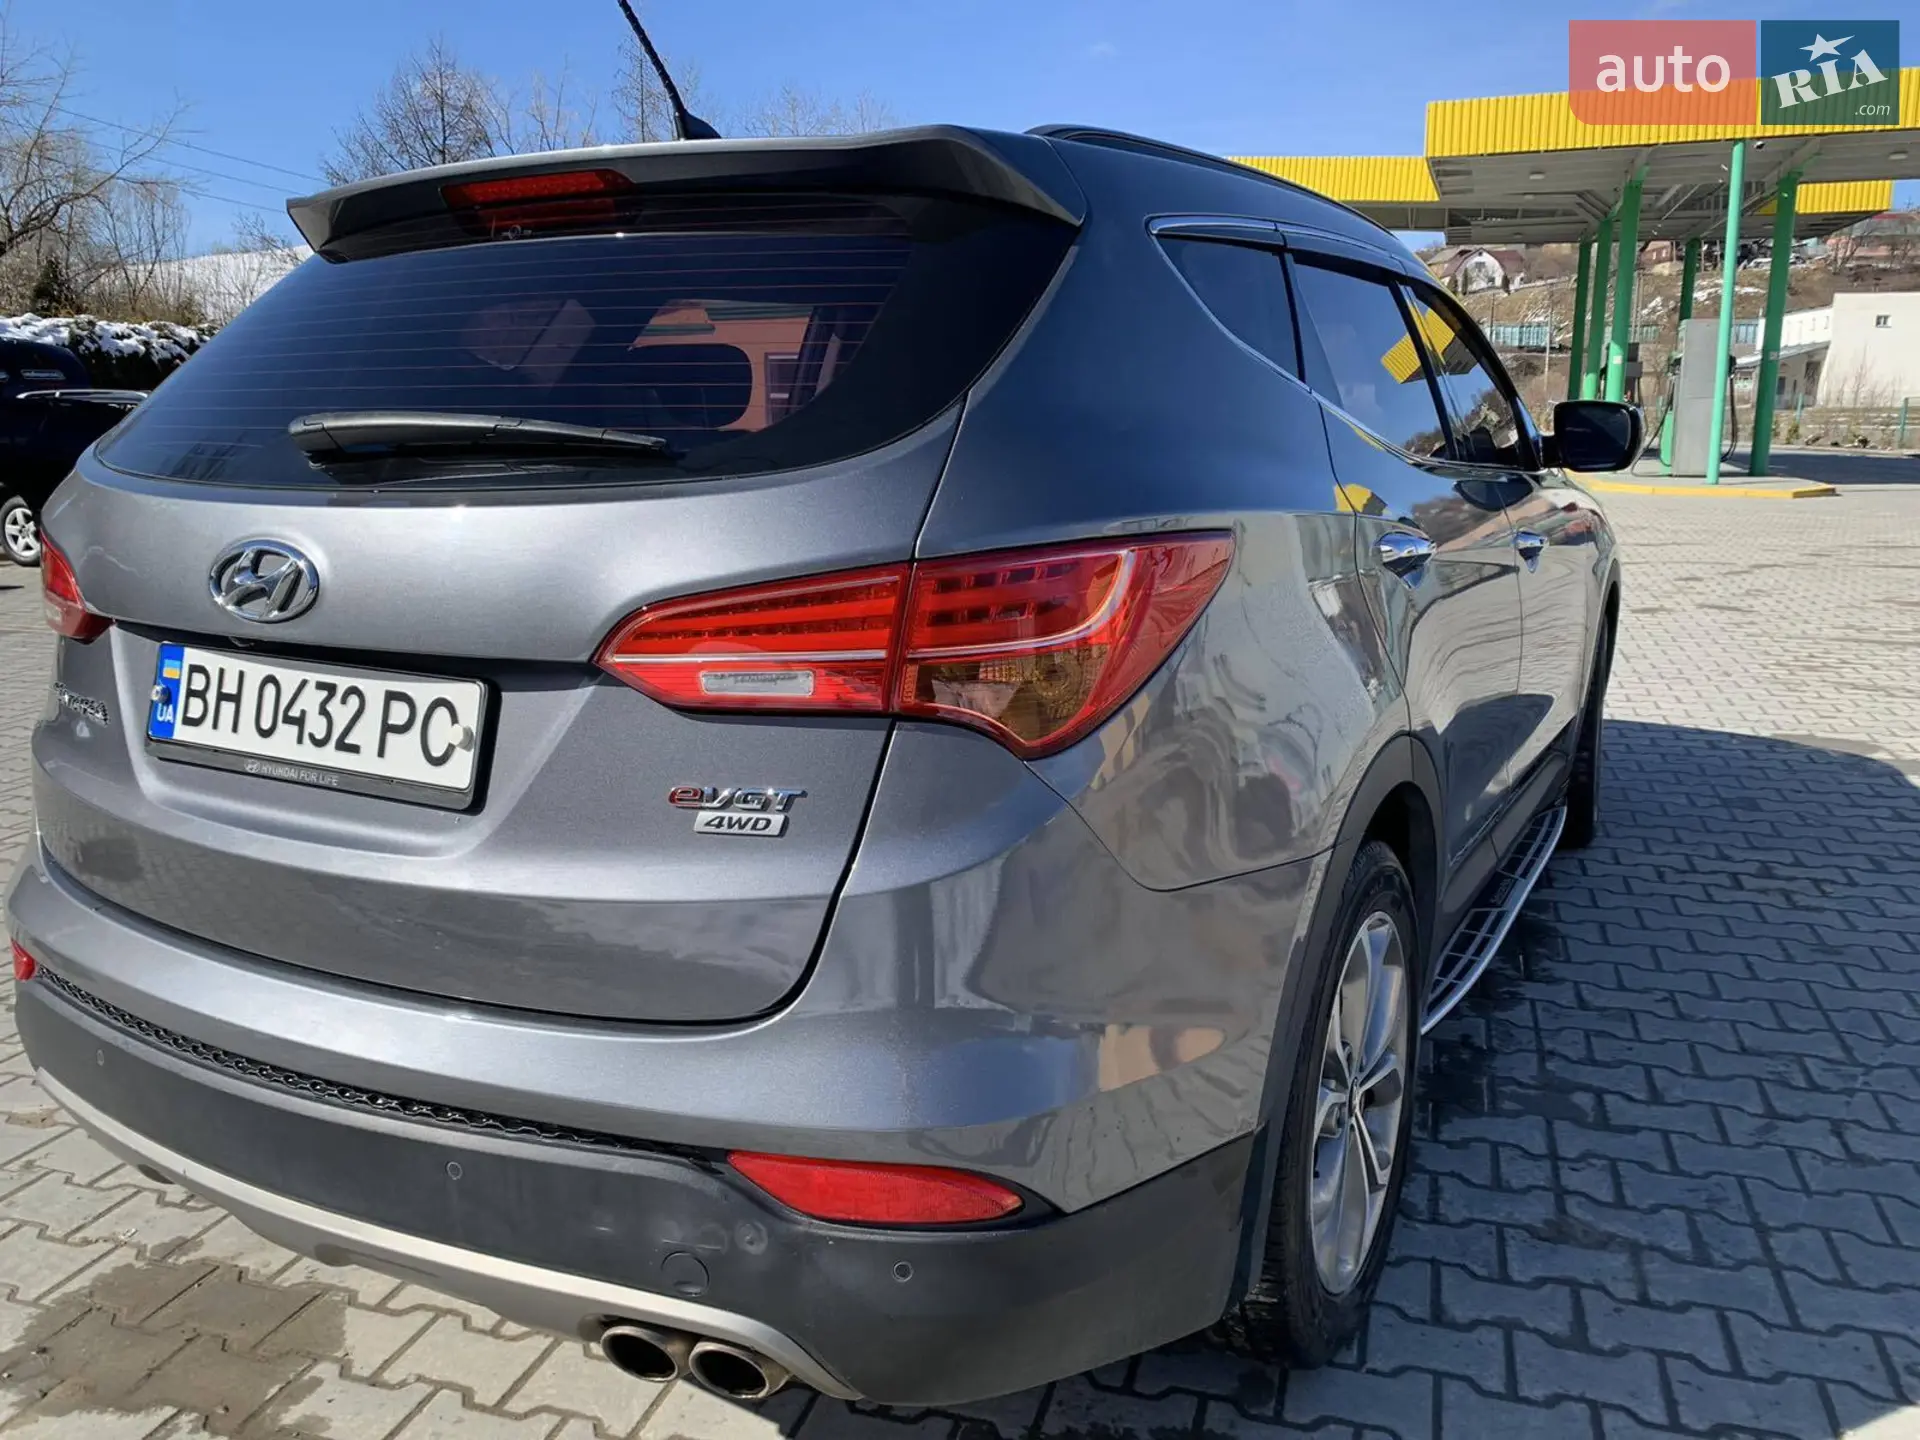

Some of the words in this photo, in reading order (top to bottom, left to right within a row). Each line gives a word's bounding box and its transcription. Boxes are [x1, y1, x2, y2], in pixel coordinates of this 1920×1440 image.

[157, 702, 175, 723] UA
[181, 663, 246, 733] BH
[254, 673, 367, 755] 0432
[377, 689, 461, 767] PC
[261, 765, 298, 780] HYUNDAI
[299, 770, 318, 783] FOR
[318, 773, 339, 787] LIFE
[703, 815, 772, 832] 4WD
